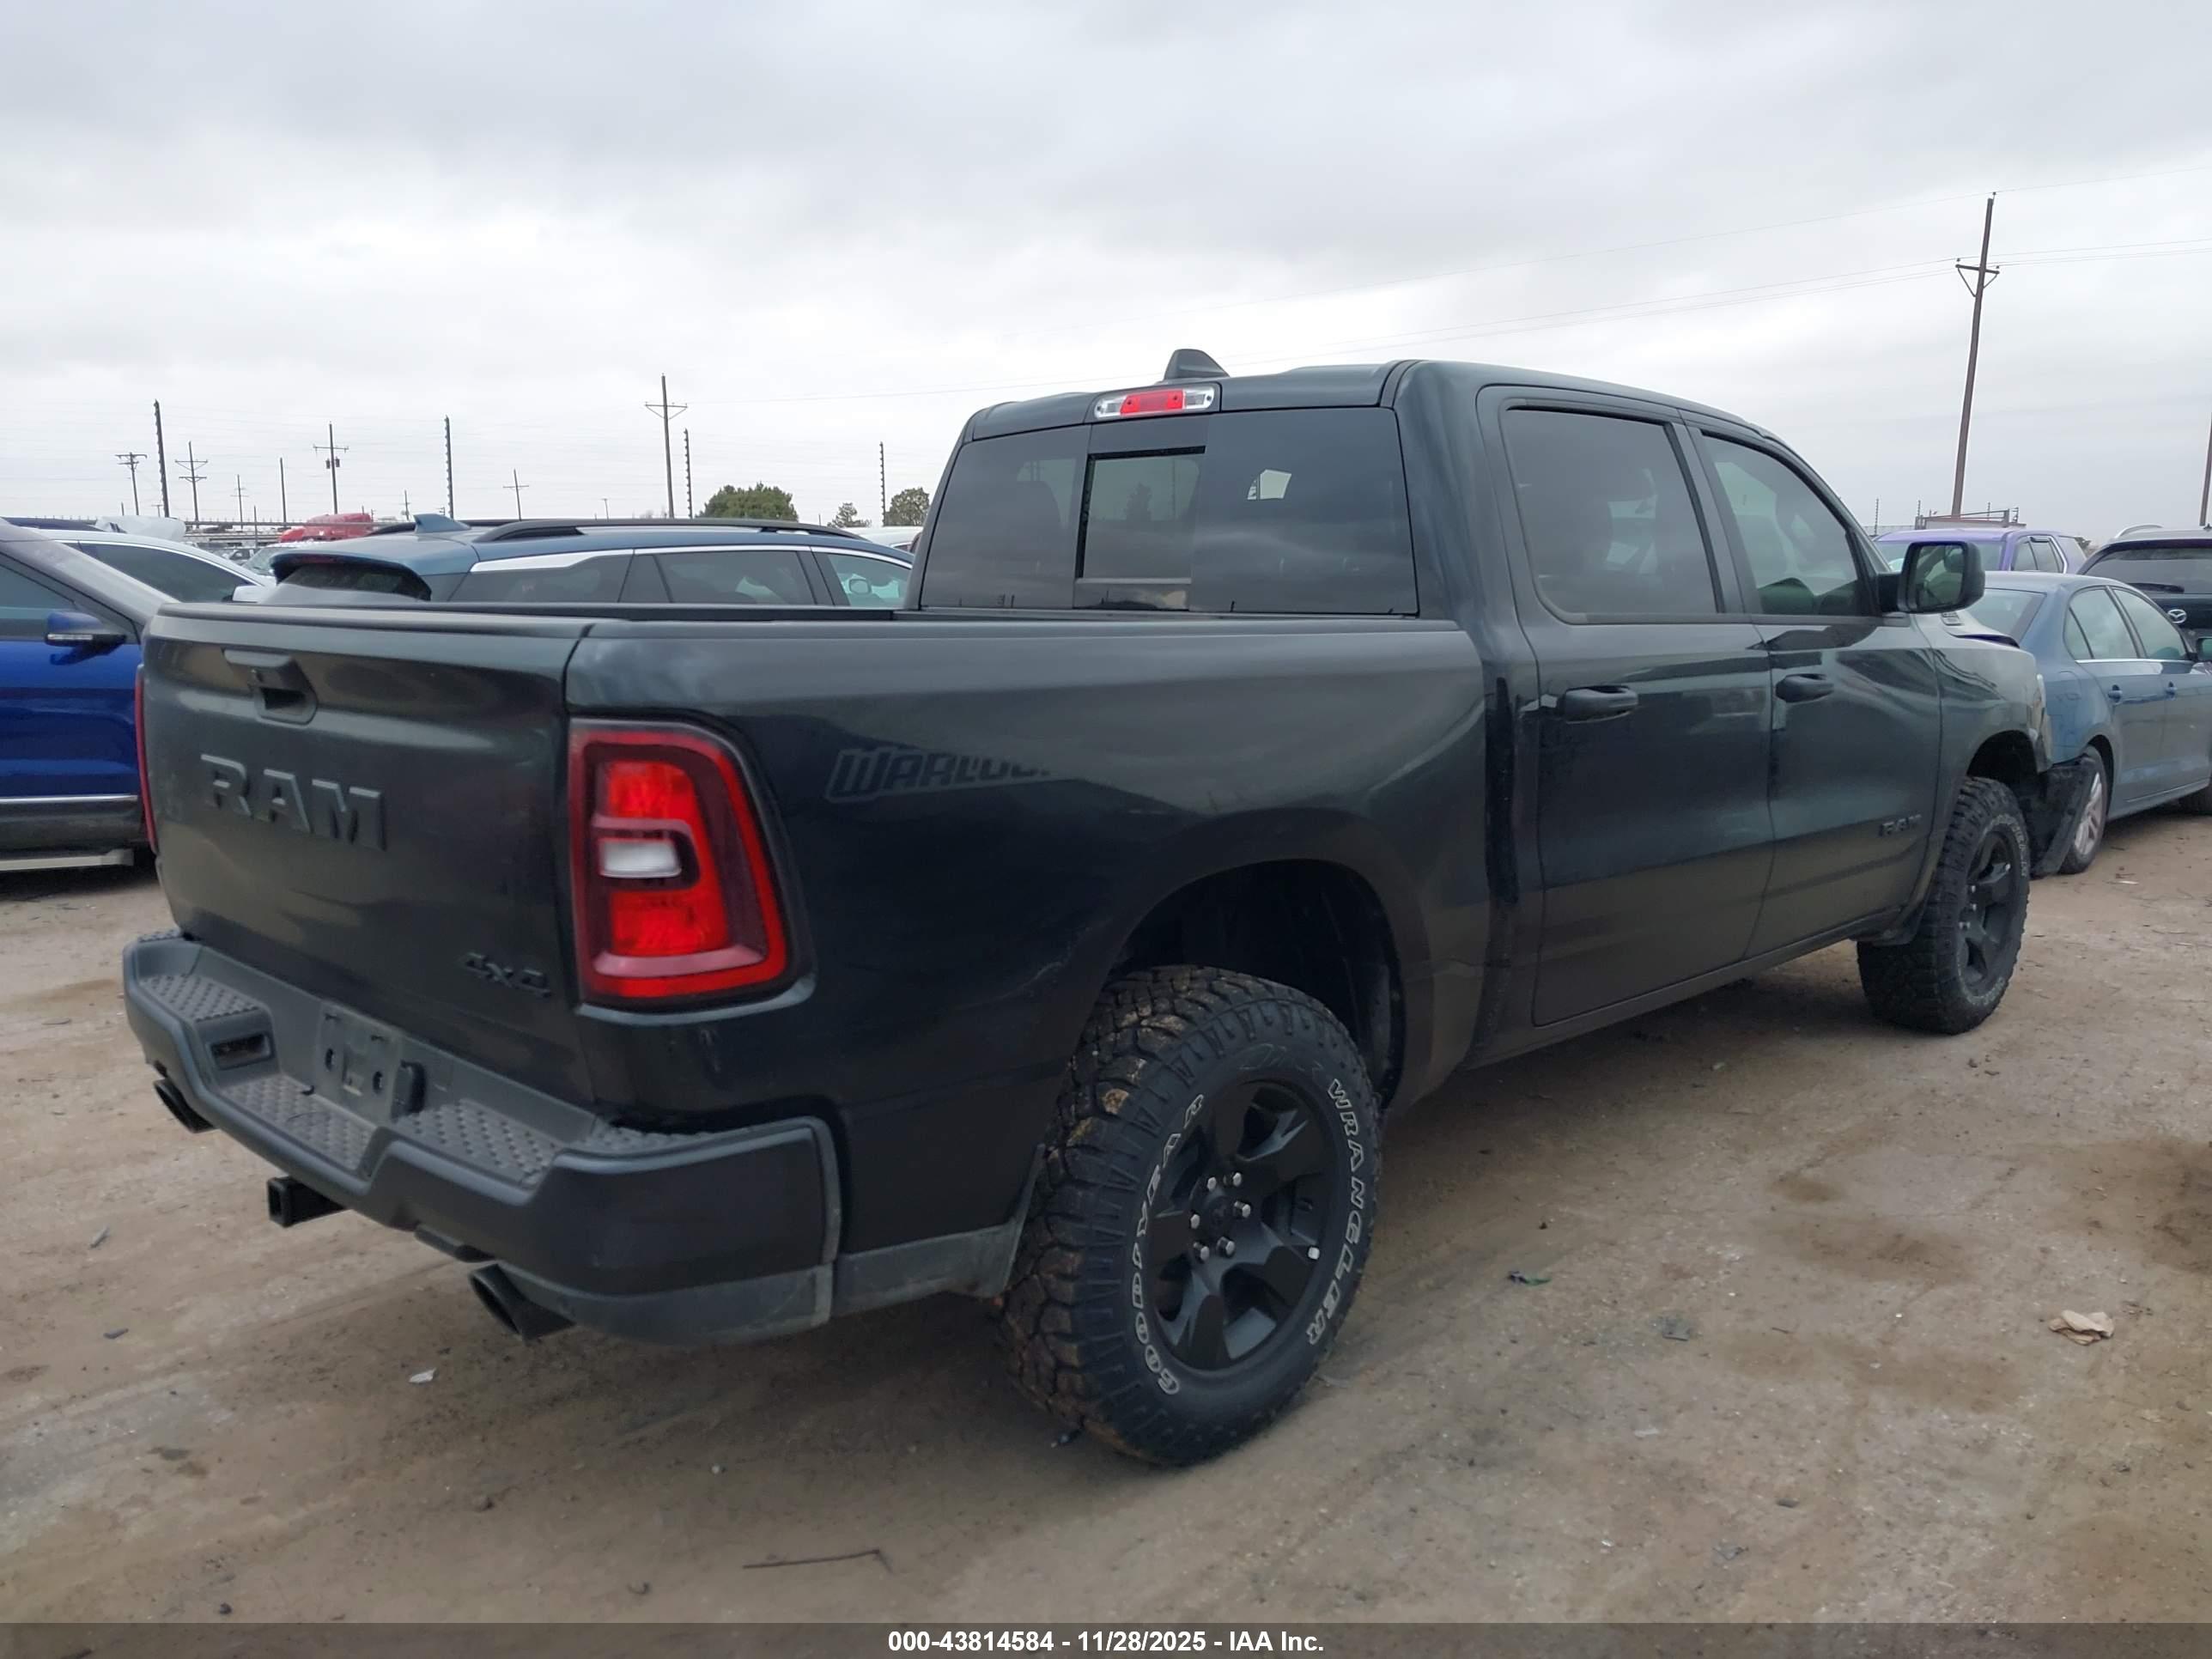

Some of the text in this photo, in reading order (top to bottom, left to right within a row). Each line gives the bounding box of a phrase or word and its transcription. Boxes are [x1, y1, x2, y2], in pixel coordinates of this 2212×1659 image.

[200, 754, 387, 852] RAM
[1131, 1094, 1204, 1395] GOODYEAR
[1306, 1079, 1366, 1346] WRANGLER
